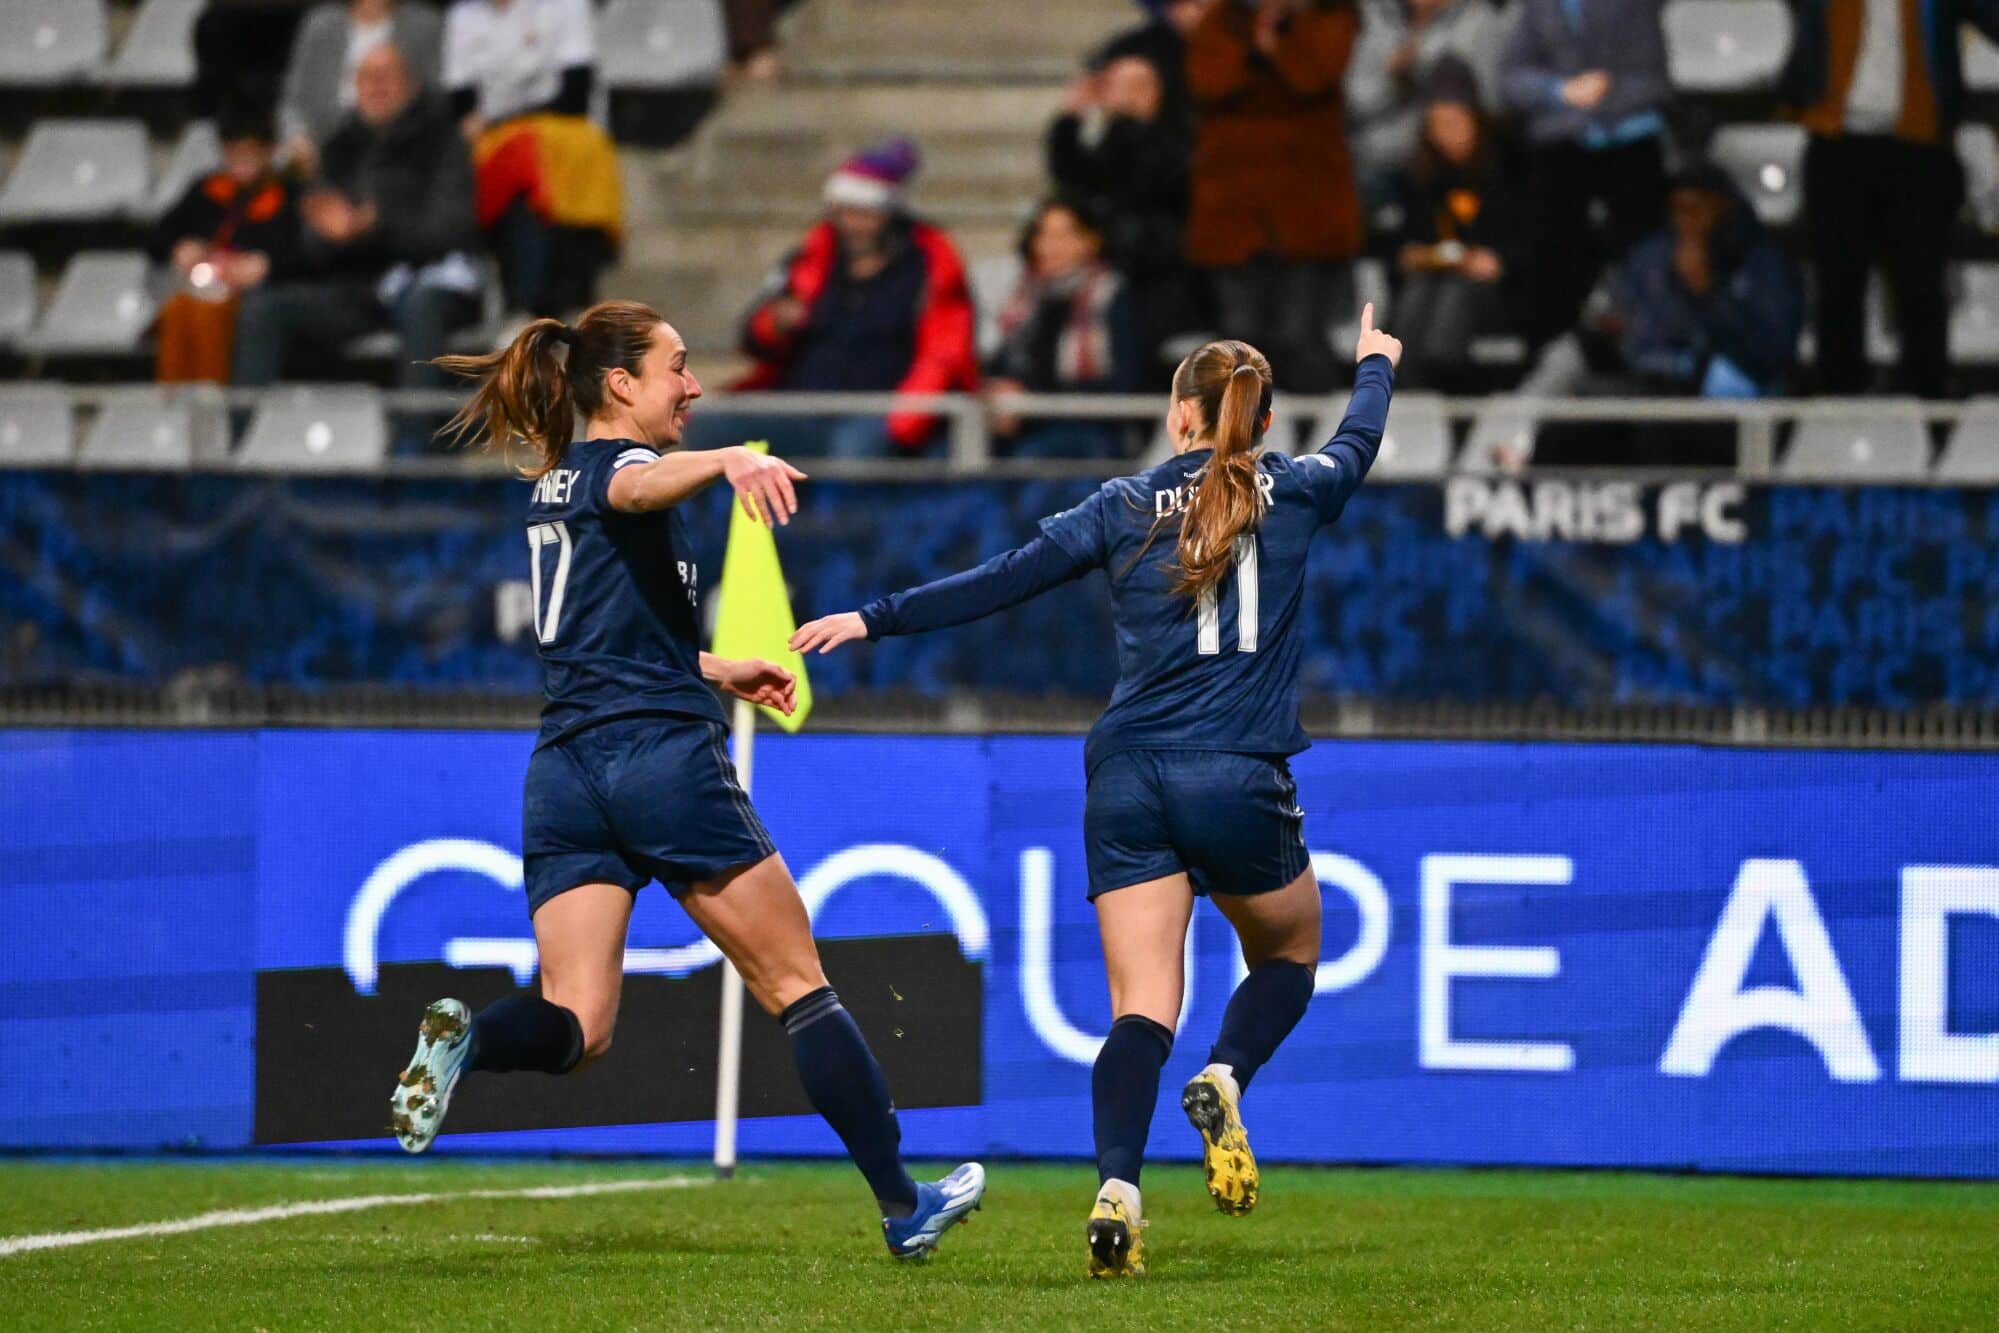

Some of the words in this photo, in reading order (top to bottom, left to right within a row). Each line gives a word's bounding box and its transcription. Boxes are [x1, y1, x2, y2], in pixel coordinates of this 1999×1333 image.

[1155, 473, 1275, 518] DUR
[1446, 477, 1644, 542] PARIS
[1657, 484, 1748, 543] FC
[527, 520, 572, 645] 17
[1194, 533, 1259, 655] 11
[342, 838, 1576, 1073] GOUPE
